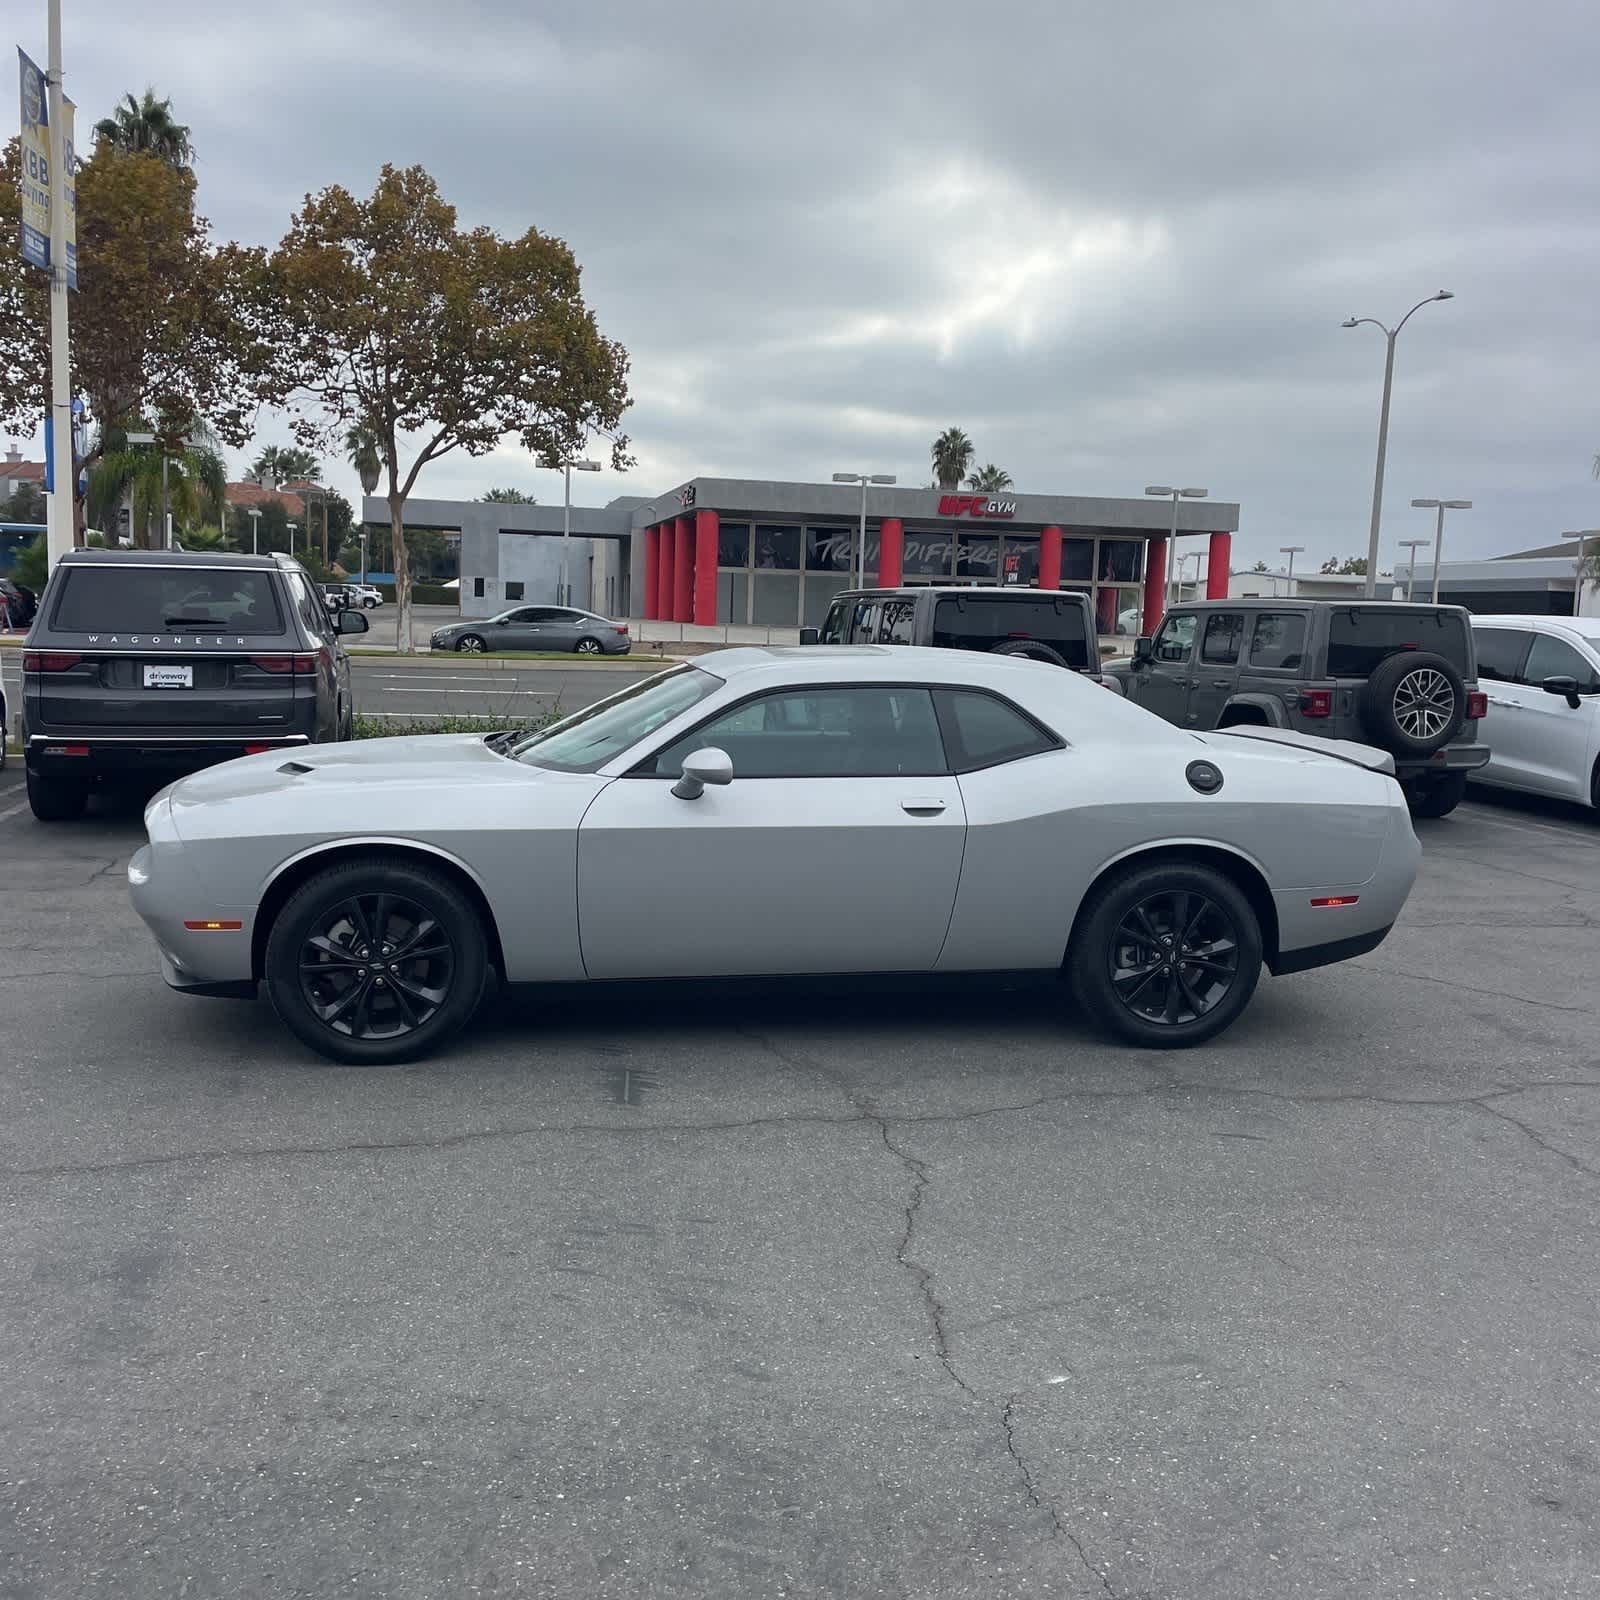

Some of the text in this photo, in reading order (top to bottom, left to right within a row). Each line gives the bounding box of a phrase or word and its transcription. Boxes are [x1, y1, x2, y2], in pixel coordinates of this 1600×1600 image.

[938, 495, 1017, 517] UFC GYM
[1005, 555, 1021, 572] UFC
[88, 635, 245, 645] WAGONEER
[148, 670, 188, 681] driveway
